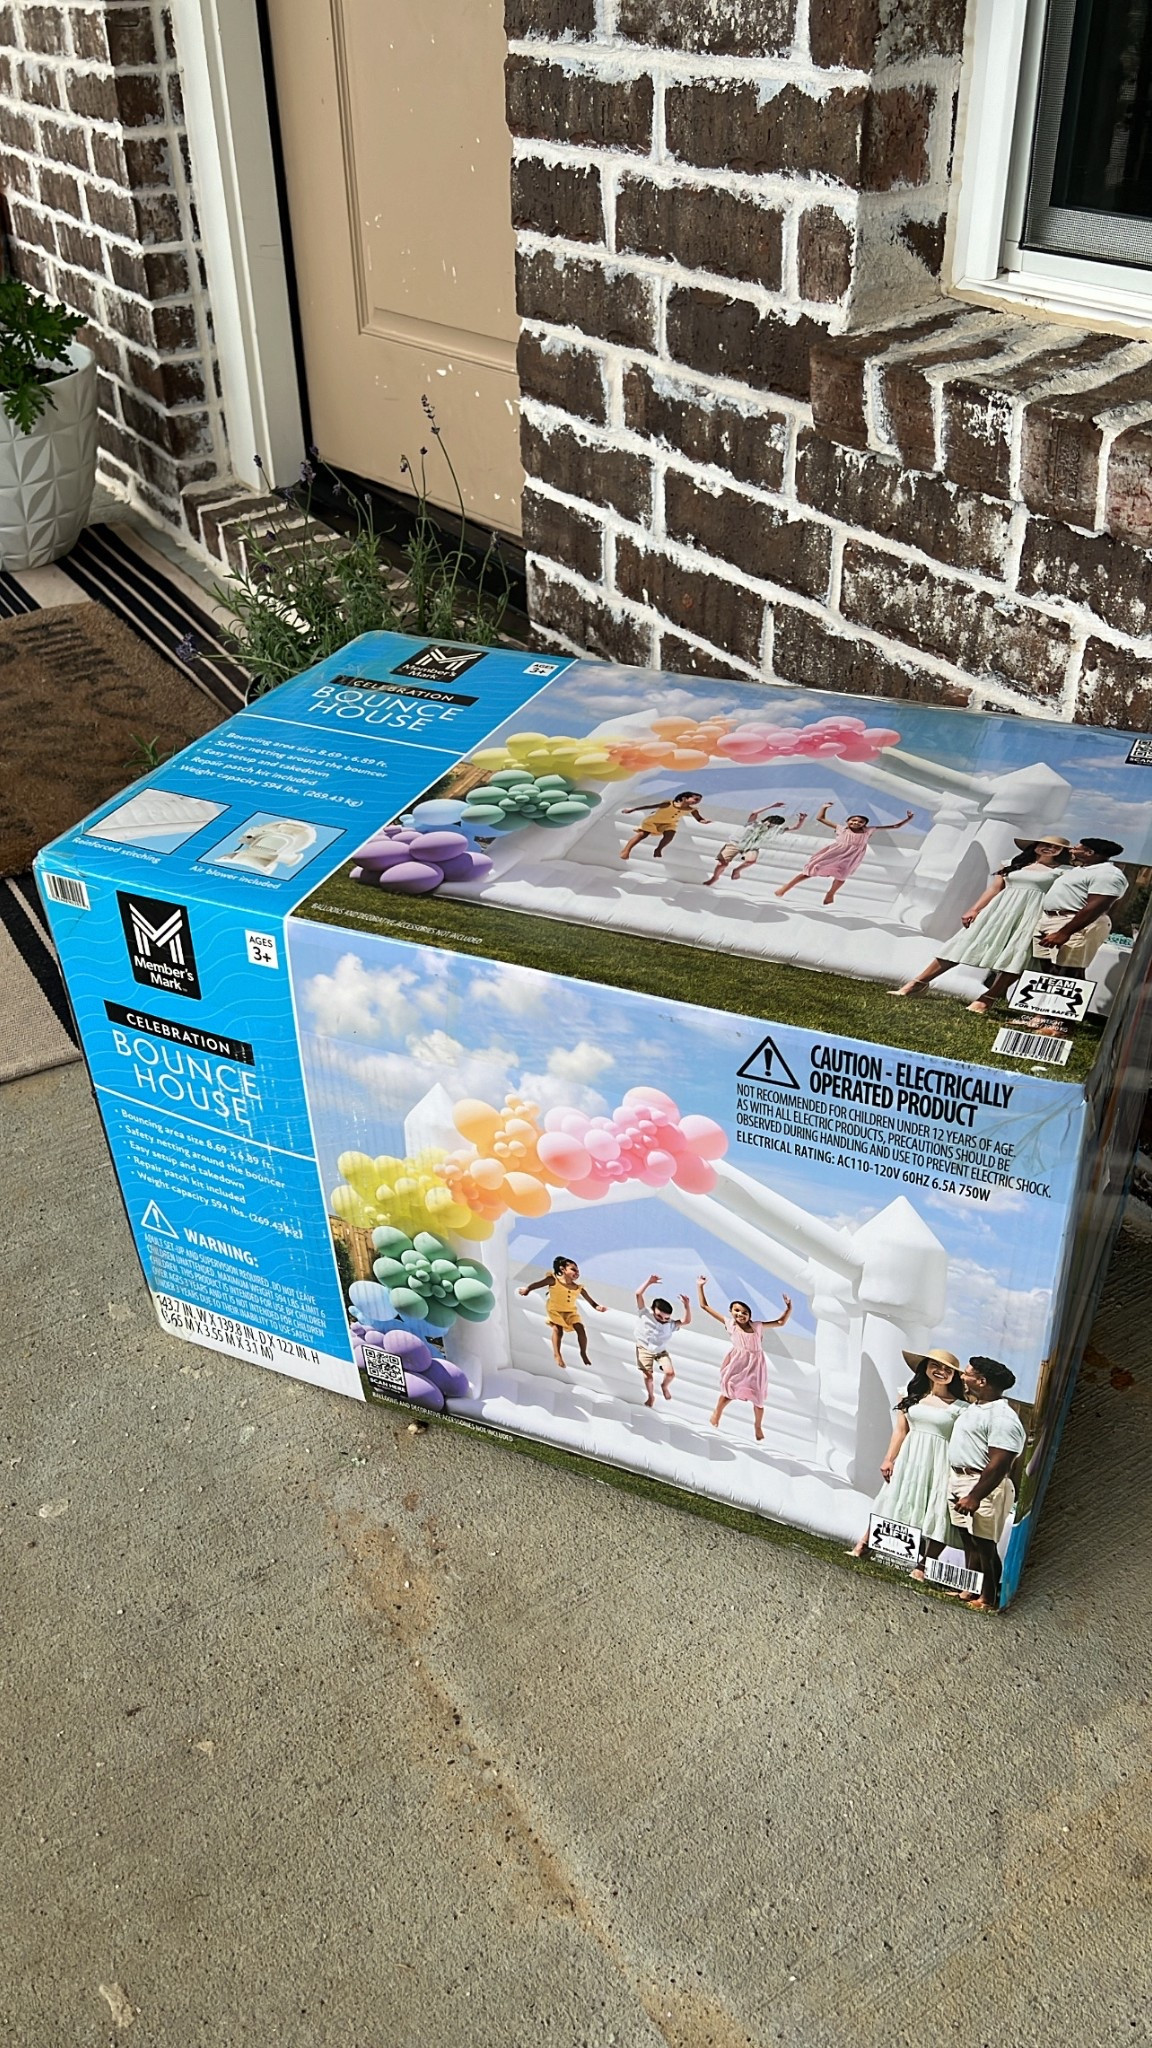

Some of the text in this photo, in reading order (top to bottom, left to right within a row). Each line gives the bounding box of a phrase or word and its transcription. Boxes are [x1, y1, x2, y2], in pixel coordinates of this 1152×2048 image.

[402, 664, 457, 677] Member's
[311, 686, 464, 721] BOUNCE
[353, 680, 453, 702] CELEBRATION
[308, 701, 433, 731] HOUSE
[201, 748, 331, 777] Easy setup and takedown
[212, 740, 389, 778] Safety netting around the bouncer
[225, 732, 274, 746] Bouncing
[271, 741, 296, 749] area
[316, 750, 342, 758] 8.69
[349, 756, 375, 764] 6.89
[176, 764, 365, 808] Weight capacity 594 lbs. (269.43 kg)
[188, 756, 225, 768] Repair
[221, 762, 256, 774] patch
[270, 772, 318, 786] included
[70, 836, 162, 864] Reinforced stitching
[188, 864, 281, 890] Air blower included
[248, 934, 273, 948] AGES
[252, 946, 272, 963] 3+
[133, 954, 194, 982] Member's
[1041, 976, 1074, 988] TEAM
[1036, 984, 1072, 997] LIFT
[125, 1012, 230, 1055] CELEBRATION
[1052, 1010, 1079, 1018] SAFETY
[111, 1029, 260, 1100] BOUNCE
[811, 1045, 882, 1082] CAUTION
[896, 1062, 1014, 1109] ELECTRICALLY
[133, 1063, 250, 1125] HOUSE
[809, 1070, 978, 1127] OPERATED PRODUCT
[120, 1108, 164, 1133] Bouncing
[163, 1126, 185, 1139] area
[186, 1133, 203, 1145] size
[205, 1139, 227, 1154] 8.69
[236, 1149, 259, 1164] 6.89
[261, 1159, 274, 1169] ft.
[736, 1083, 1017, 1157] NOT RECOMMENDED FOR CHILDREN UNDER 12 YEARS OF AGE.
[736, 1097, 1010, 1171] AS WITH ALL ELECTRIC PRODUCTS, PRECAUTIONS SHOULD BE
[124, 1125, 286, 1190] Safety netting around the bouncer
[128, 1140, 244, 1189] Easy setup and takedown
[736, 1112, 1052, 1198] OBSERVED DURING HANDLING AND USE TO PREVENT ELECTRIC SHOCK.
[737, 1130, 990, 1202] ELECTRICAL RATING: AC110-120V 60HZ 6.5A 750W
[133, 1155, 245, 1204] Repair patch kit included
[136, 1169, 303, 1241] Weight capacity 594 lbs. (269.43 kg)
[183, 1227, 259, 1268] WARNING:
[182, 1302, 196, 1319] IN.
[196, 1308, 207, 1323] W
[208, 1312, 216, 1327] X
[217, 1316, 243, 1336] 139.8
[243, 1325, 257, 1342] IN.
[258, 1331, 266, 1345] D
[267, 1334, 276, 1349] X
[276, 1338, 295, 1356] 122
[295, 1344, 311, 1361] IN.
[310, 1350, 320, 1364] H
[184, 1317, 195, 1331] M
[195, 1320, 203, 1335] X
[203, 1324, 224, 1342] 3.55
[225, 1332, 235, 1346] M
[236, 1335, 244, 1350] X
[245, 1339, 258, 1355] 3.1
[260, 1345, 274, 1361] M)
[882, 1527, 907, 1540] LIFT
[884, 1521, 909, 1534] TEAM
